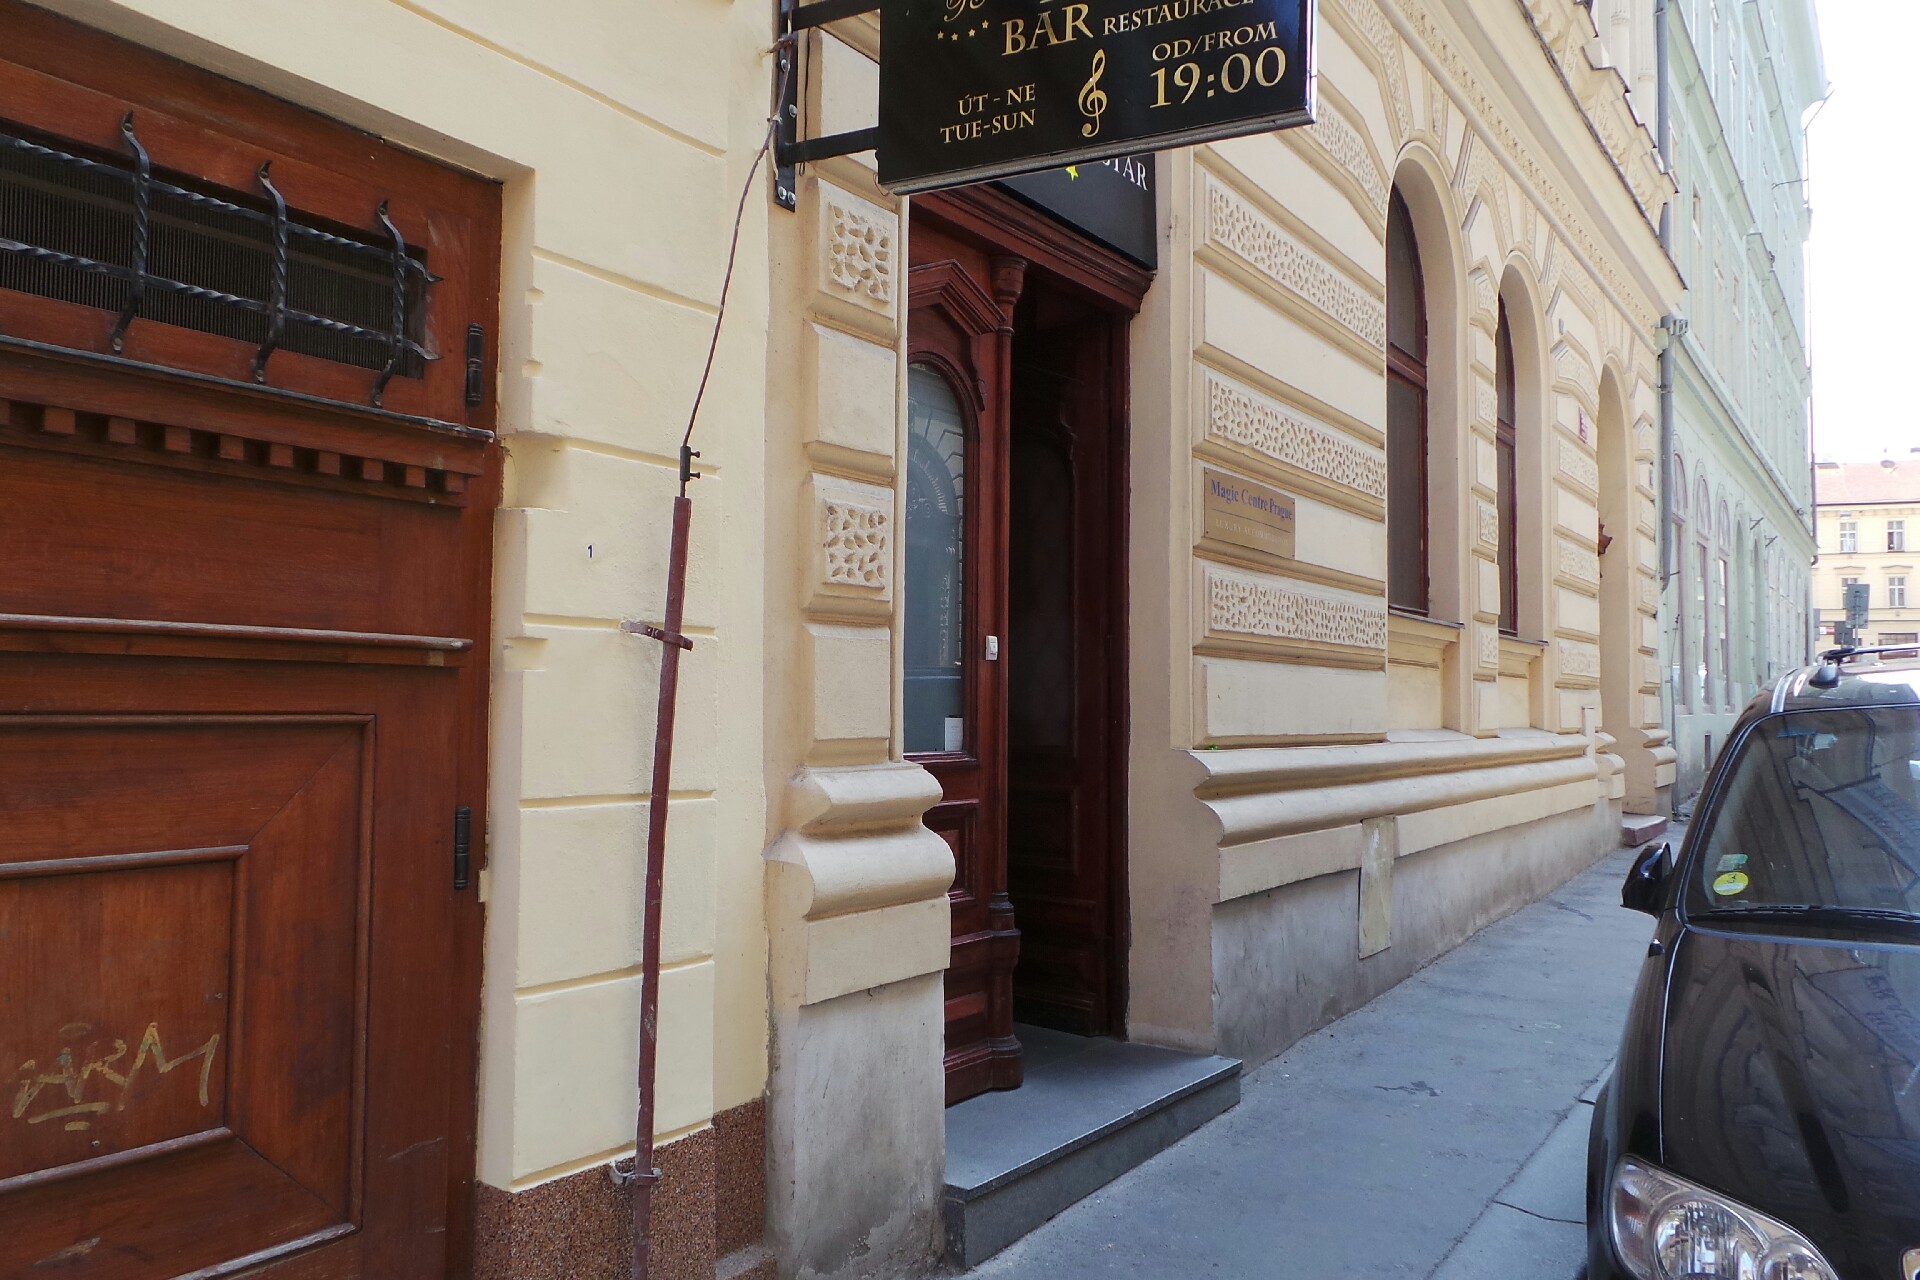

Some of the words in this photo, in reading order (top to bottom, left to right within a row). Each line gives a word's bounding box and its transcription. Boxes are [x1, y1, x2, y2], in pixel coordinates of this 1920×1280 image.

[1001, 3, 1094, 56] BAR
[1103, 0, 1254, 36] RESTAURA
[1152, 21, 1278, 61] OD/FROM
[1150, 46, 1286, 108] 19:00
[958, 93, 988, 116] ÚT
[1006, 83, 1035, 105] NE
[940, 108, 1035, 143] TUE-SUN
[1102, 156, 1148, 191] TAR
[1211, 480, 1239, 504] Magic
[1241, 489, 1268, 511] Centre
[1269, 498, 1293, 521] Prague
[587, 544, 593, 558] 1
